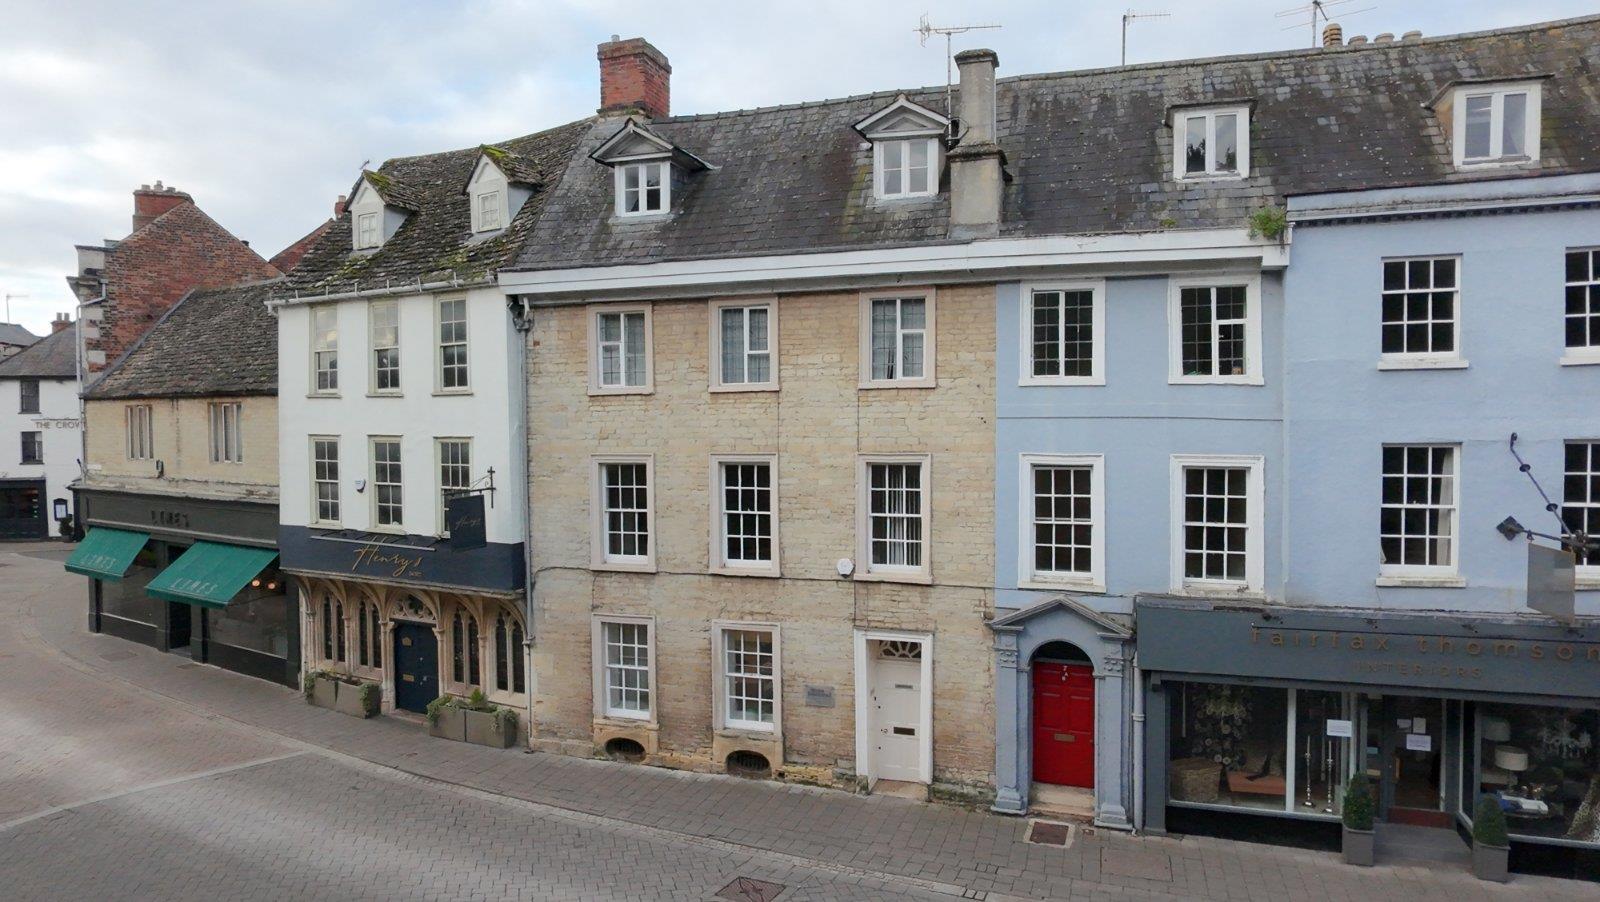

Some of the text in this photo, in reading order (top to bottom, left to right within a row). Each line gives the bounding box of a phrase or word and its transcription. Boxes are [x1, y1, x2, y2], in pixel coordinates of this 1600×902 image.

[35, 421, 50, 429] THE
[1251, 627, 1389, 650] fairfax
[1353, 660, 1483, 679] INTERIORS
